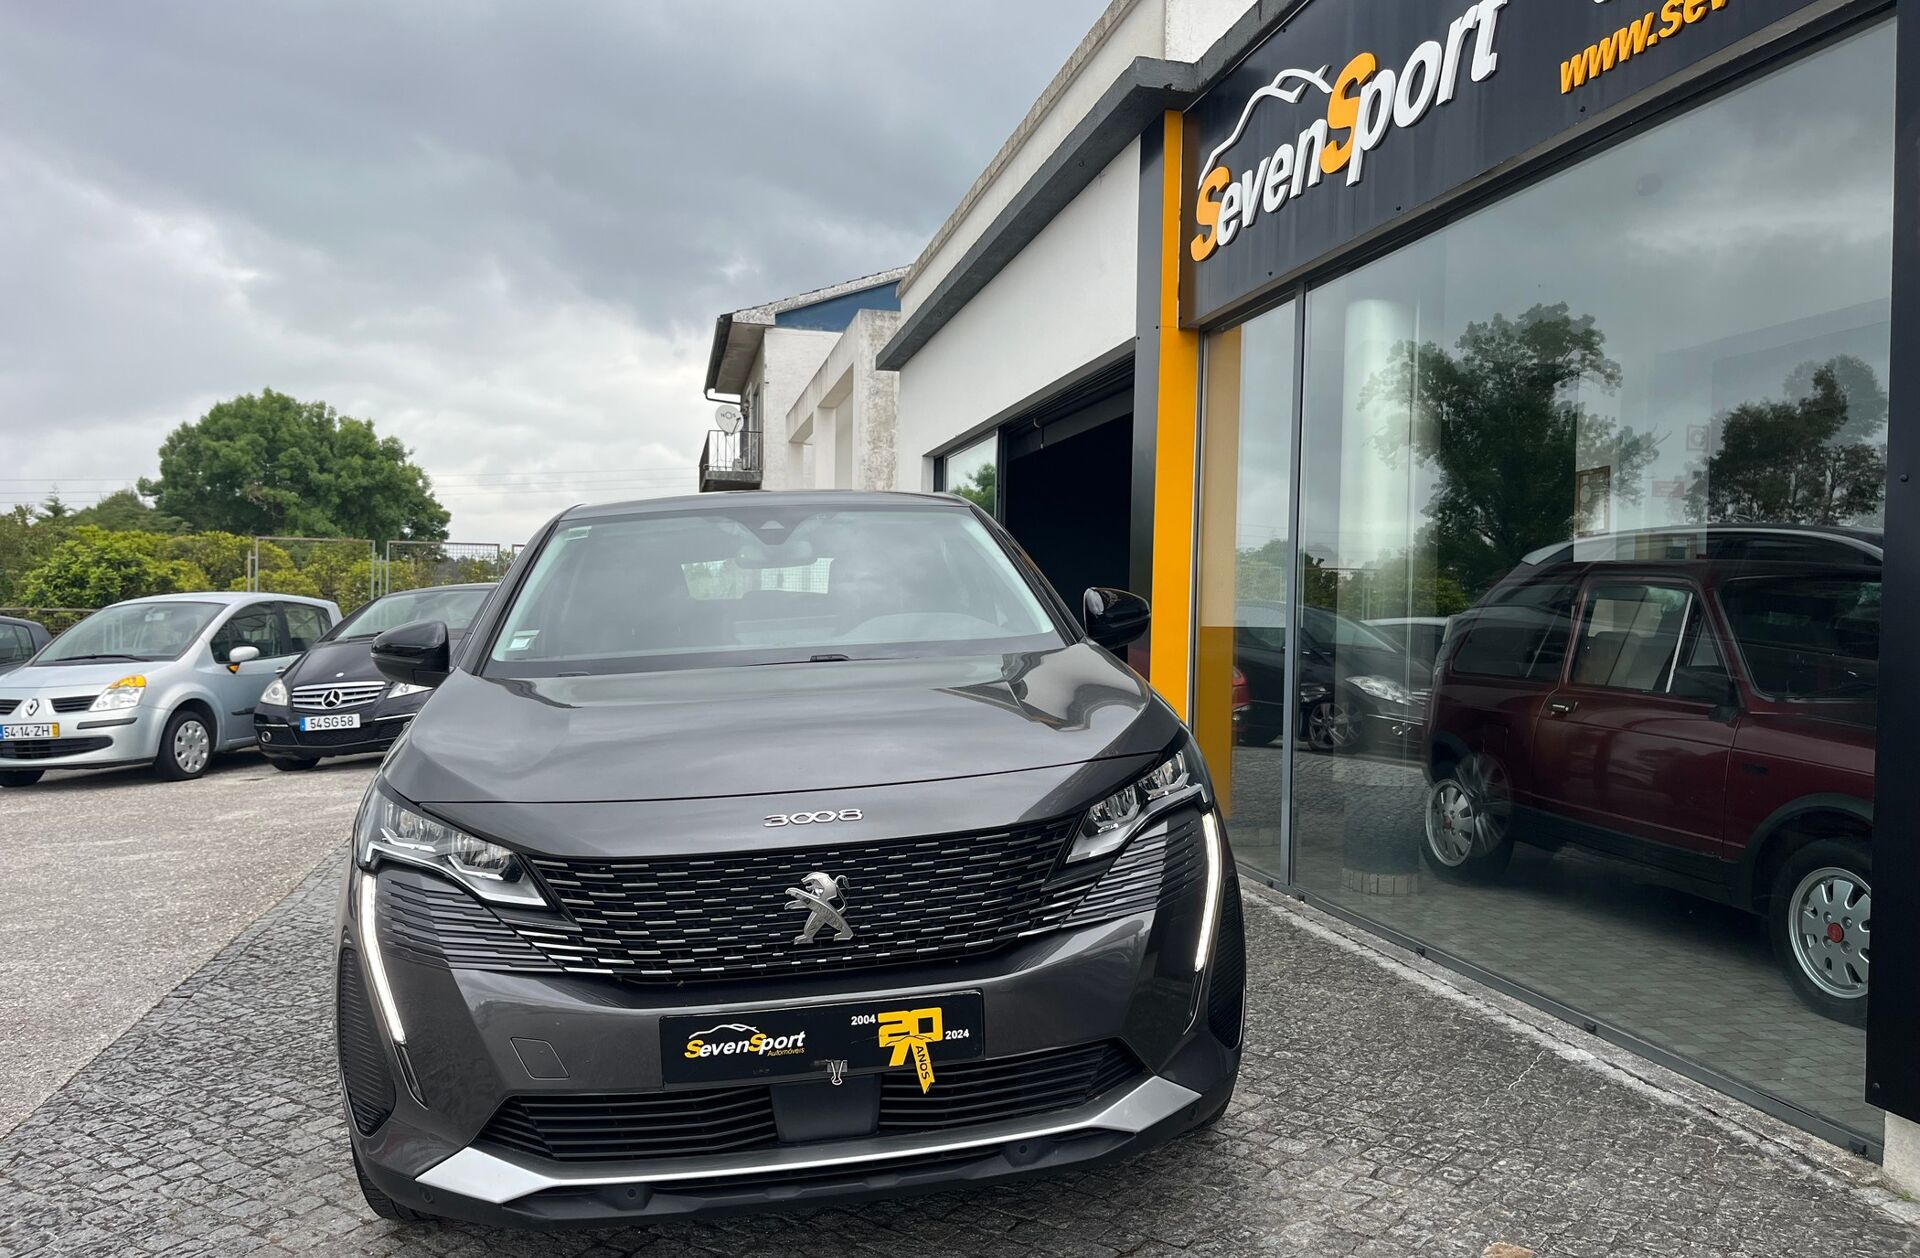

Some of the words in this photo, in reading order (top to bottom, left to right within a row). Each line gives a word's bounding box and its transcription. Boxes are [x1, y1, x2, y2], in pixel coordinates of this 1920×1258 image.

[1190, 0, 1507, 262] SevenSport
[763, 808, 864, 828] 3008
[850, 1014, 877, 1026] 2004
[944, 1028, 971, 1040] 2024
[684, 1030, 806, 1059] SevenSport
[915, 1045, 931, 1080] ANOS
